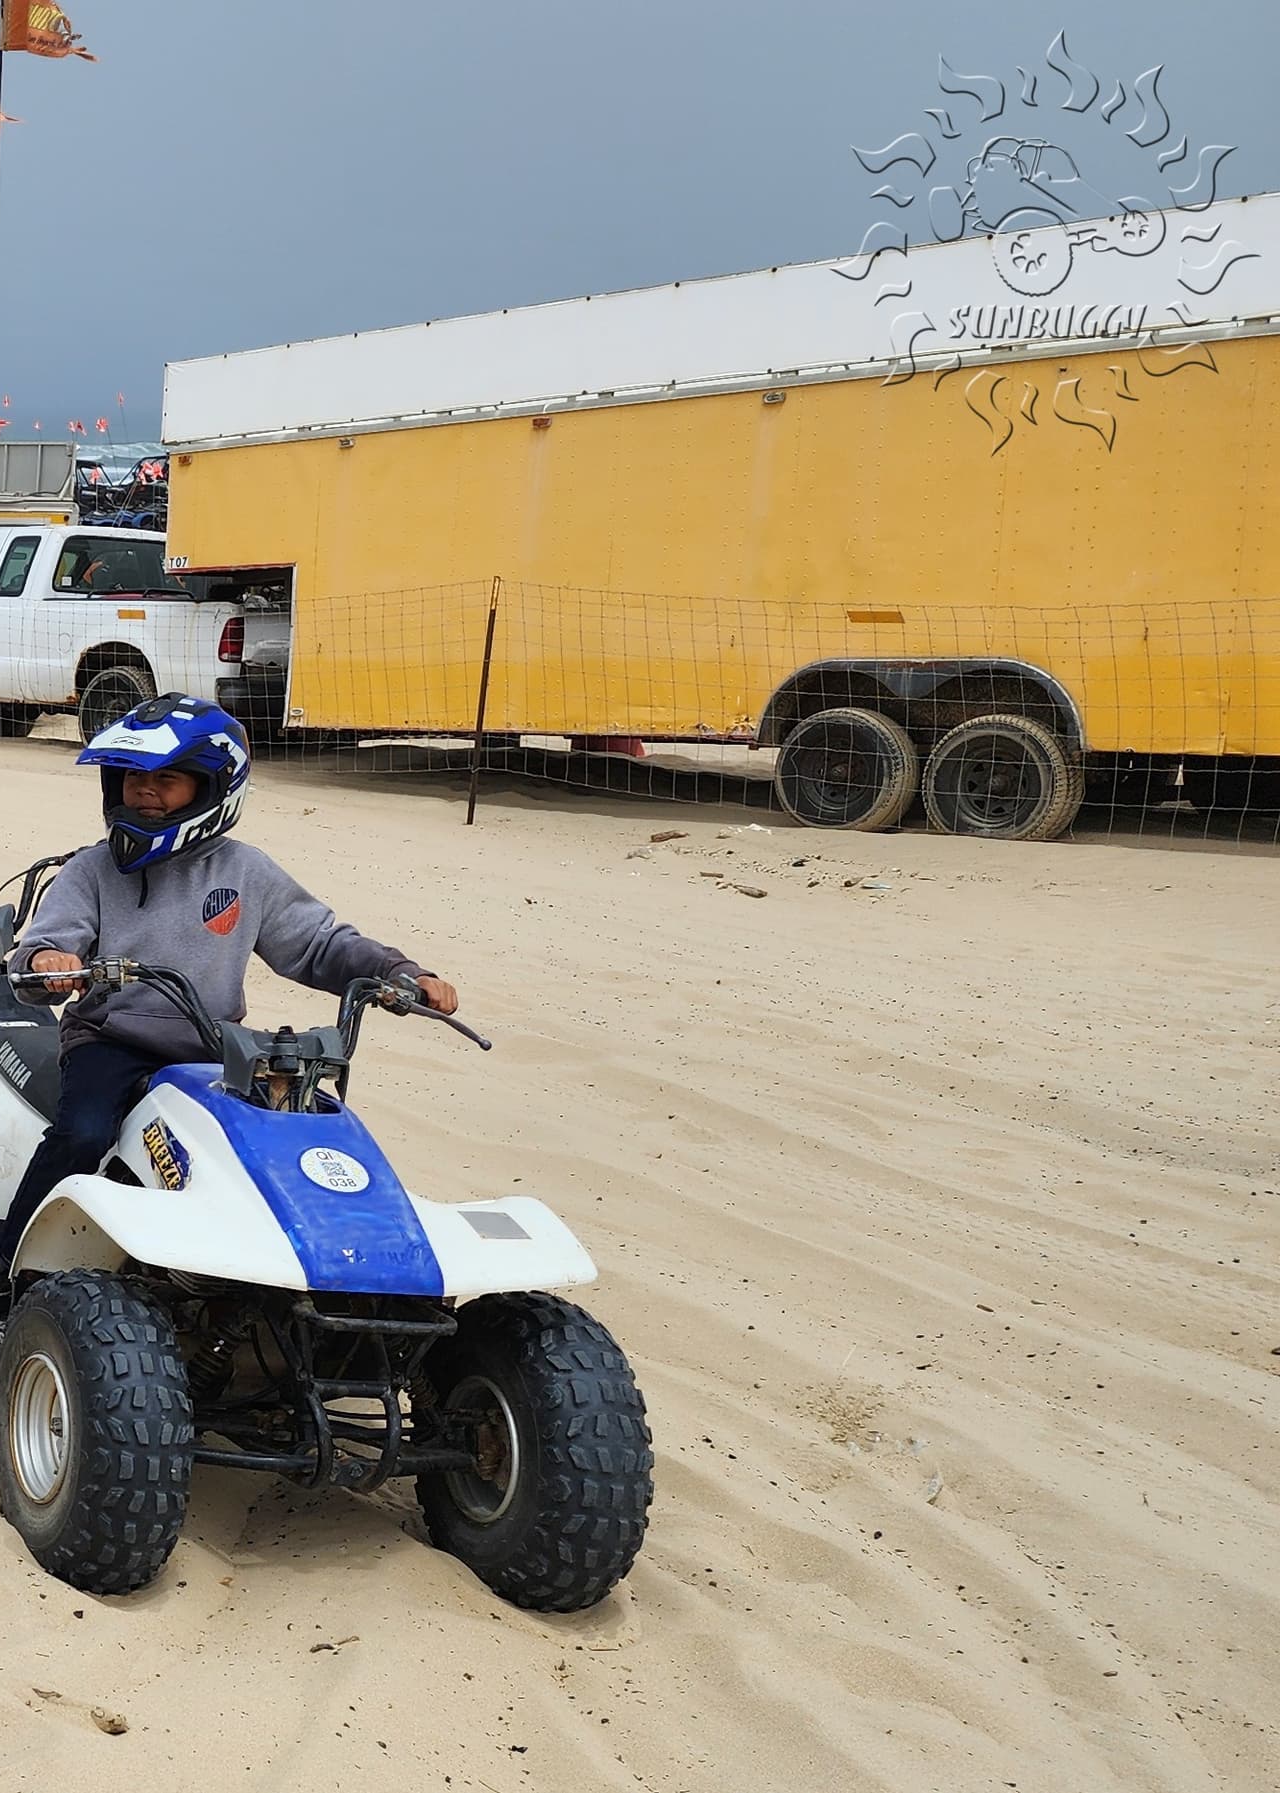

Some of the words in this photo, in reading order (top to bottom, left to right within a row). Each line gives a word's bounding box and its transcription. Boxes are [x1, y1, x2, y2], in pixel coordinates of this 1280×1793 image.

[169, 557, 175, 569] T
[175, 556, 188, 568] 07
[143, 1125, 182, 1191] BREEZE
[328, 1178, 357, 1188] 038
